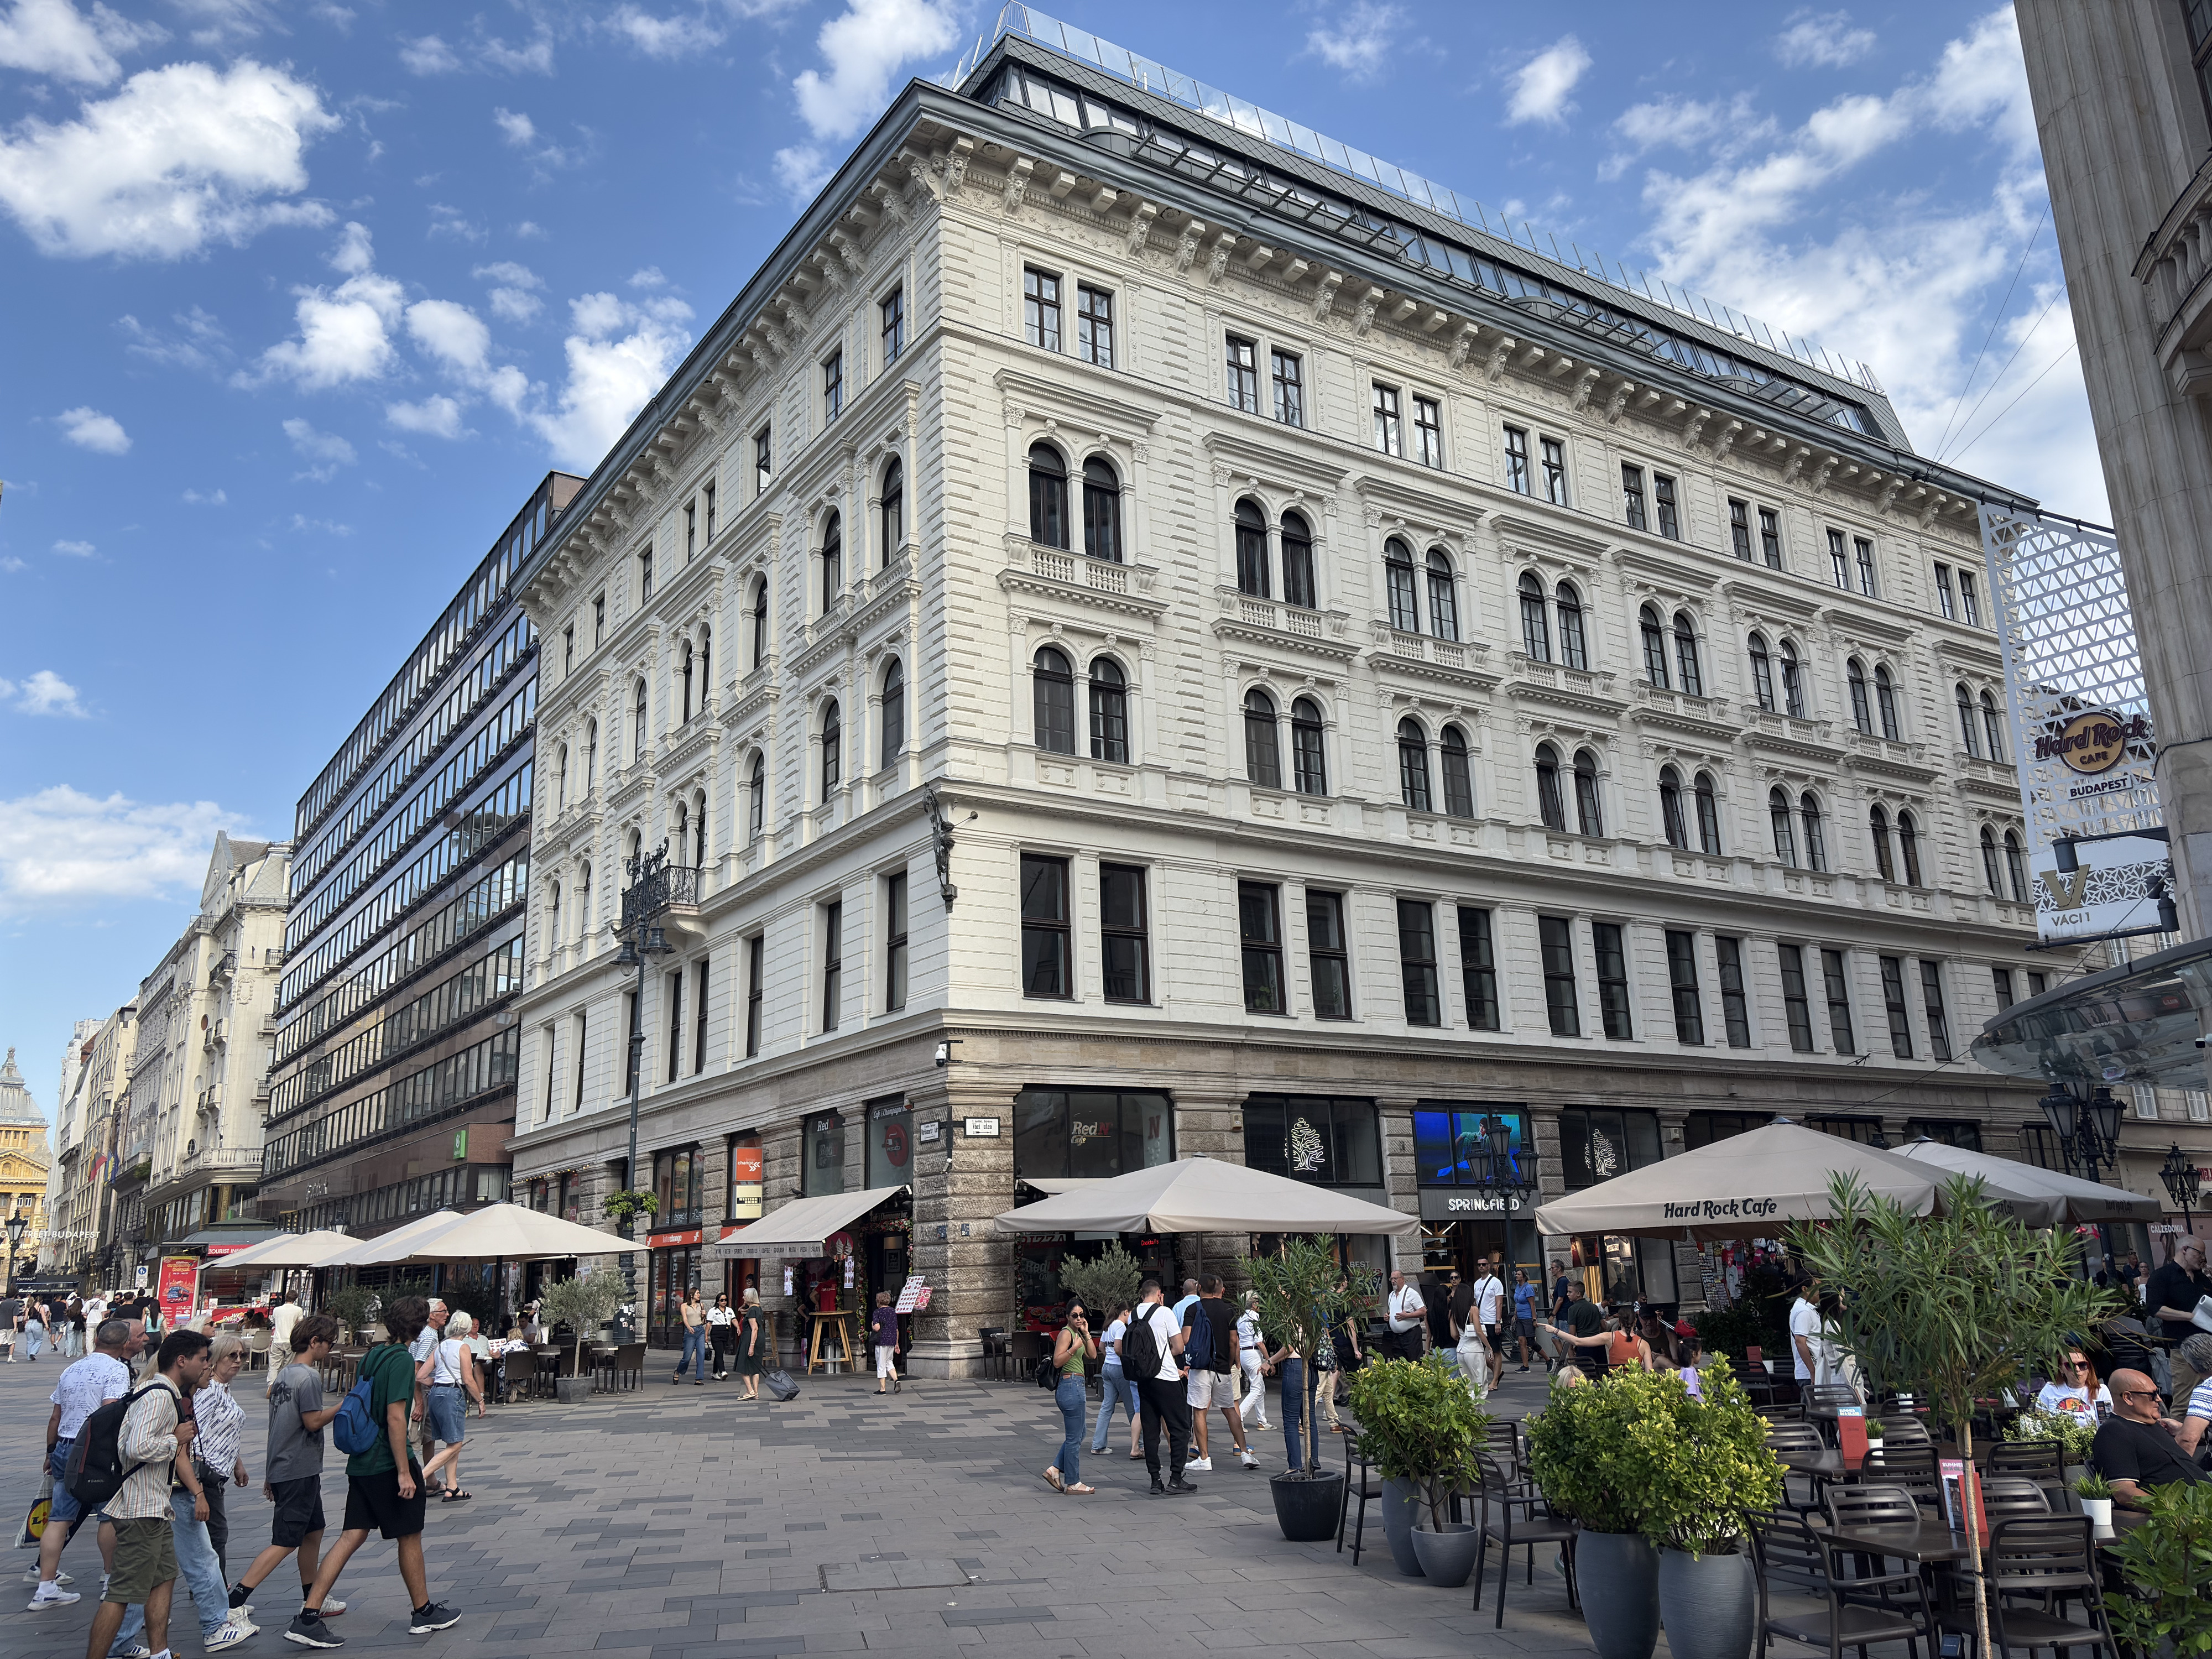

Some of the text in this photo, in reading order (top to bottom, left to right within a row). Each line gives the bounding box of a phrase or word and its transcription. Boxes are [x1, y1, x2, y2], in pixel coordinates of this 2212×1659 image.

[2034, 714, 2149, 758] Hard Rock
[2080, 751, 2108, 764] CAFE
[2070, 778, 2127, 797] BUDAPEST
[1448, 1198, 1520, 1211] SPRINGFIED
[1664, 1198, 1777, 1219] Hard Rock Cafe
[2150, 1224, 2184, 1233] CALZEDONIA
